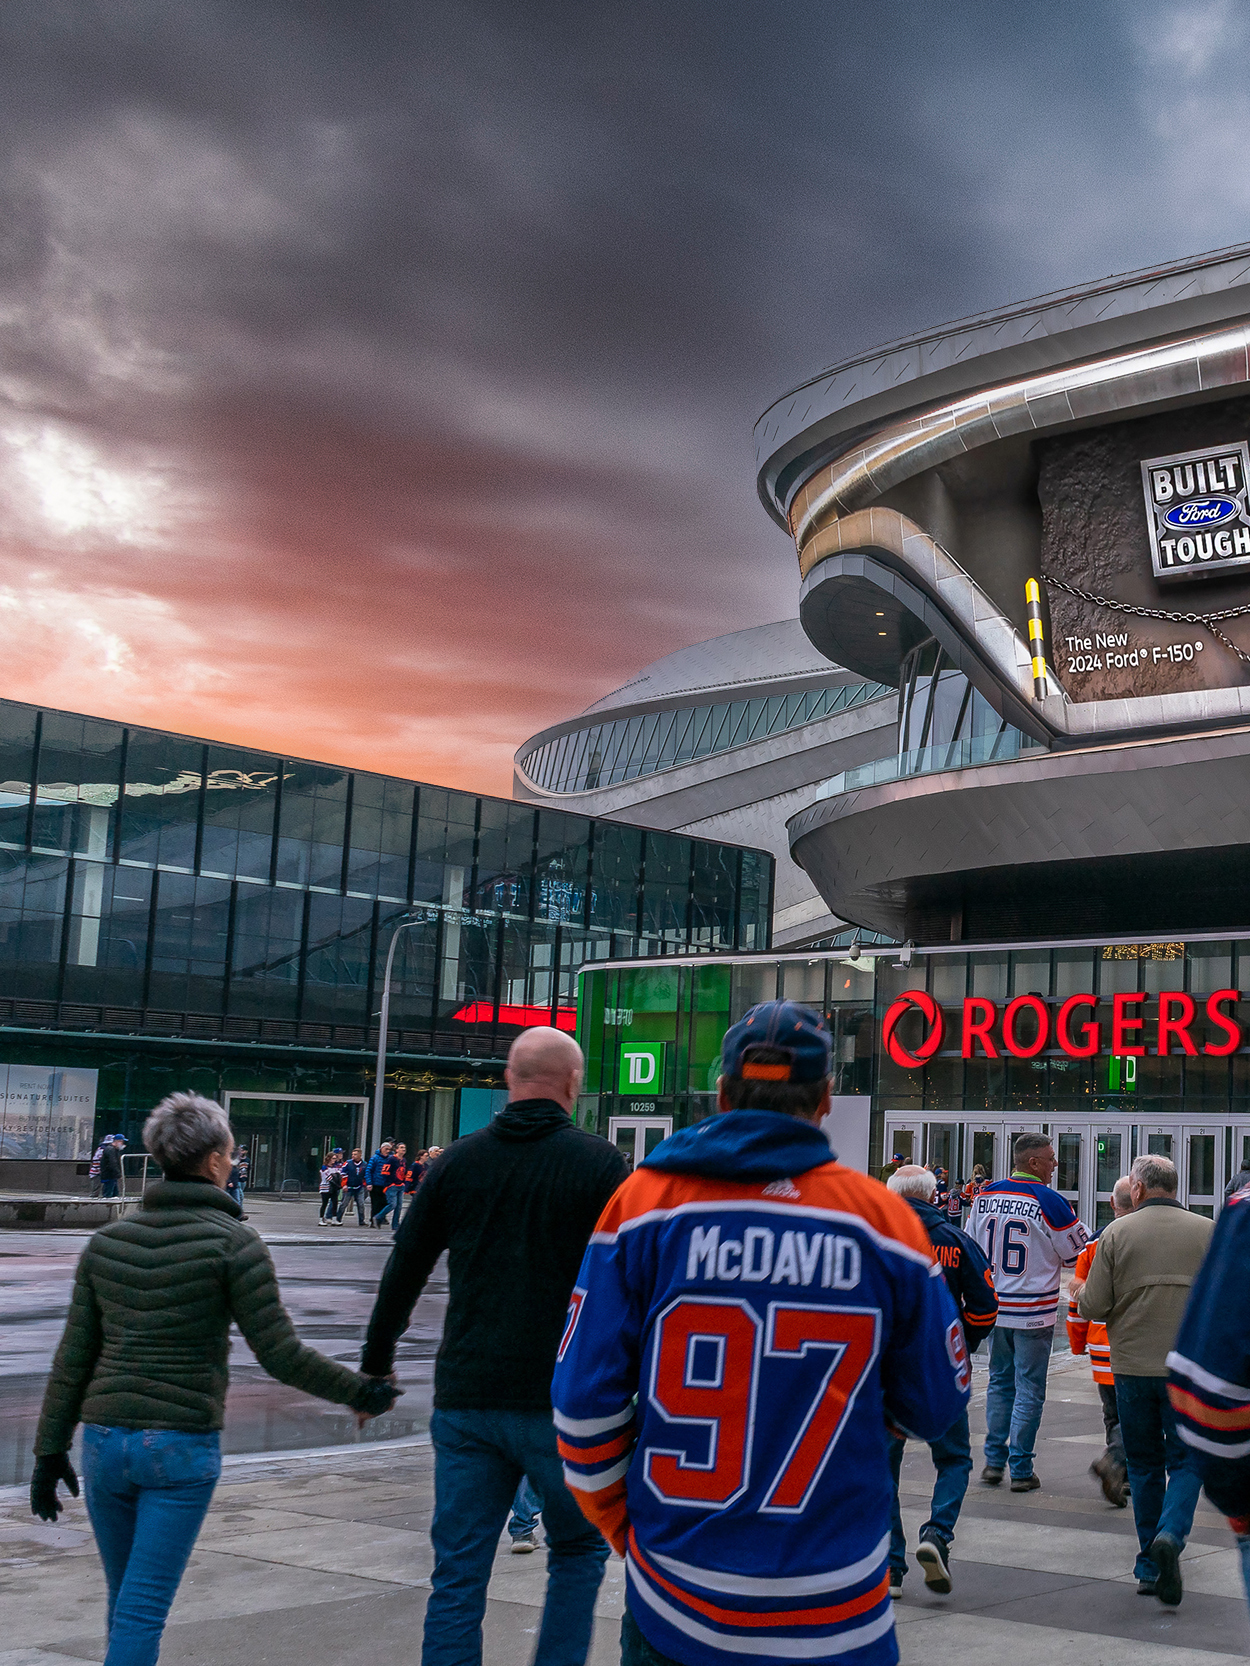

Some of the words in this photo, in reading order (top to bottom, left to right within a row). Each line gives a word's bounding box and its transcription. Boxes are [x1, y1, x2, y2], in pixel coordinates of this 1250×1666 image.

[1153, 457, 1239, 501] BUILT
[1179, 501, 1221, 523] Ford
[1065, 635, 1093, 651] The
[1095, 633, 1128, 649] New
[1067, 655, 1103, 673] 2024
[962, 988, 1243, 1060] ROGERS
[624, 1052, 656, 1084] TD
[0, 1092, 54, 1101] SIGNATURE
[58, 1095, 90, 1103] SUITES
[629, 1102, 656, 1112] 10259
[16, 1125, 74, 1133] RESIDENCES
[978, 1198, 1042, 1223] BUCHBERGER
[985, 1215, 1031, 1278] 16
[1066, 1224, 1089, 1253] 16
[686, 1224, 862, 1291] McDAVID
[643, 1294, 882, 1514] 97
